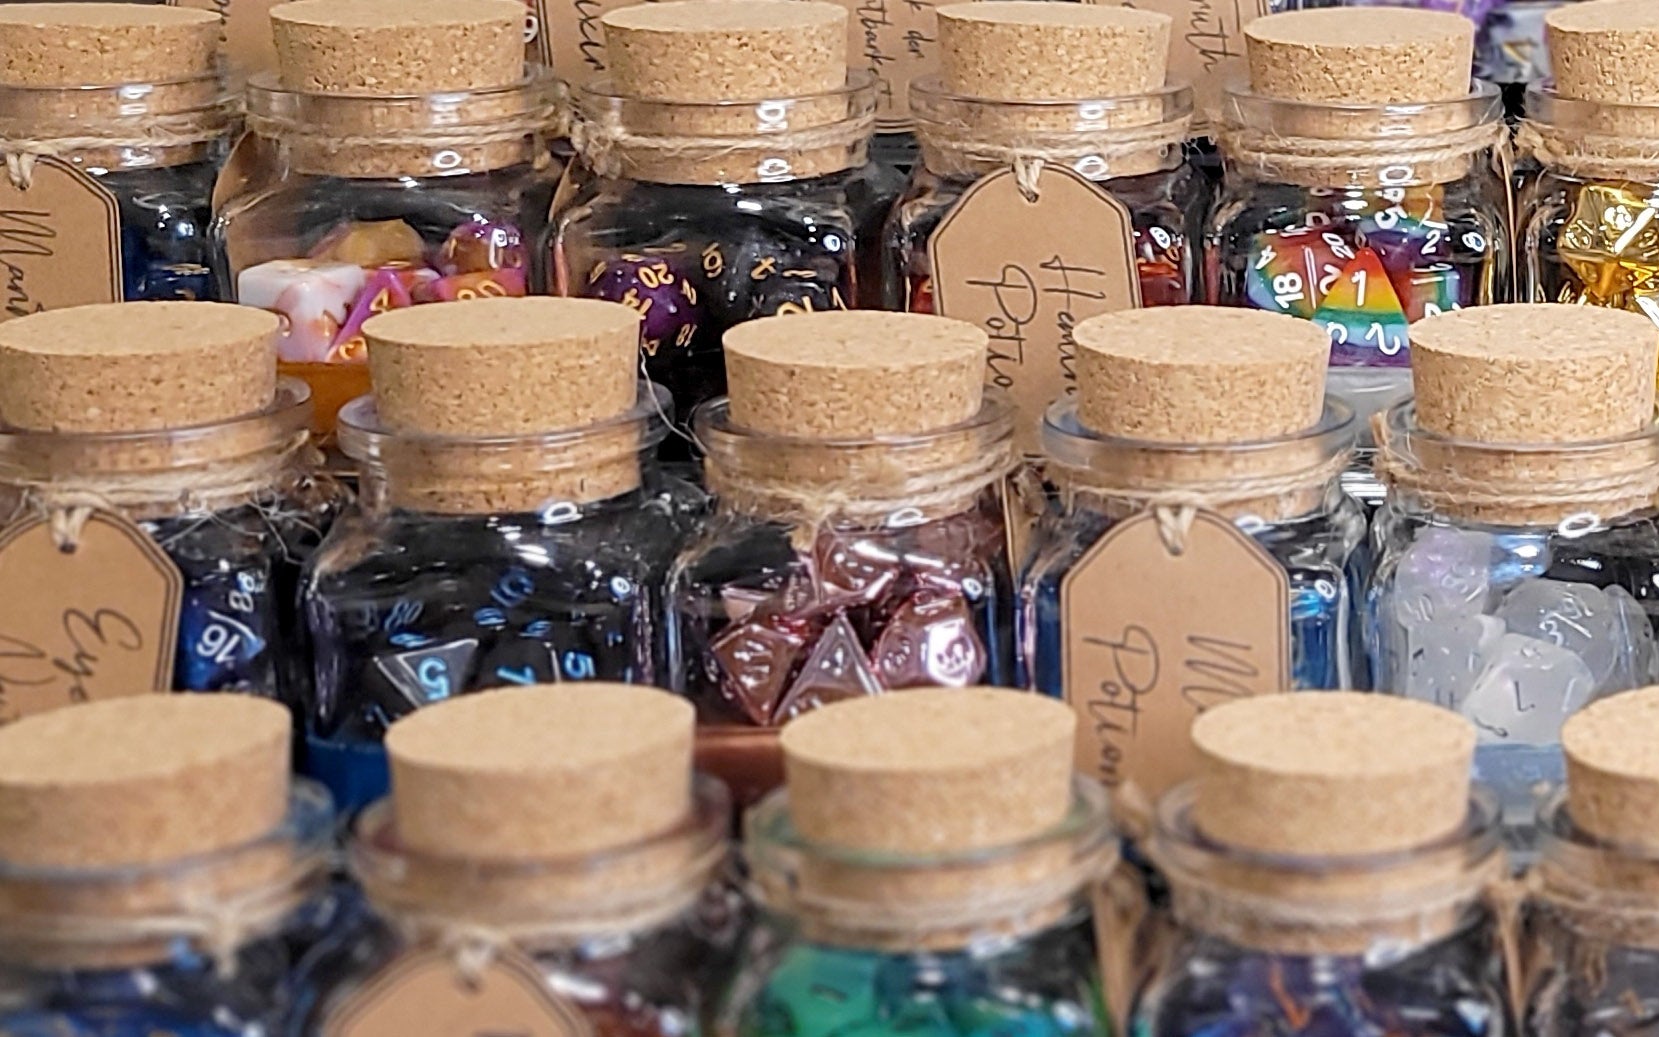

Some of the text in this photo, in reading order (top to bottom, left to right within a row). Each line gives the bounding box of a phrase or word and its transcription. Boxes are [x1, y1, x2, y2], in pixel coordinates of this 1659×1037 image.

[1272, 272, 1305, 309] 18
[1351, 270, 1367, 307] 1
[966, 264, 1038, 388] Potio
